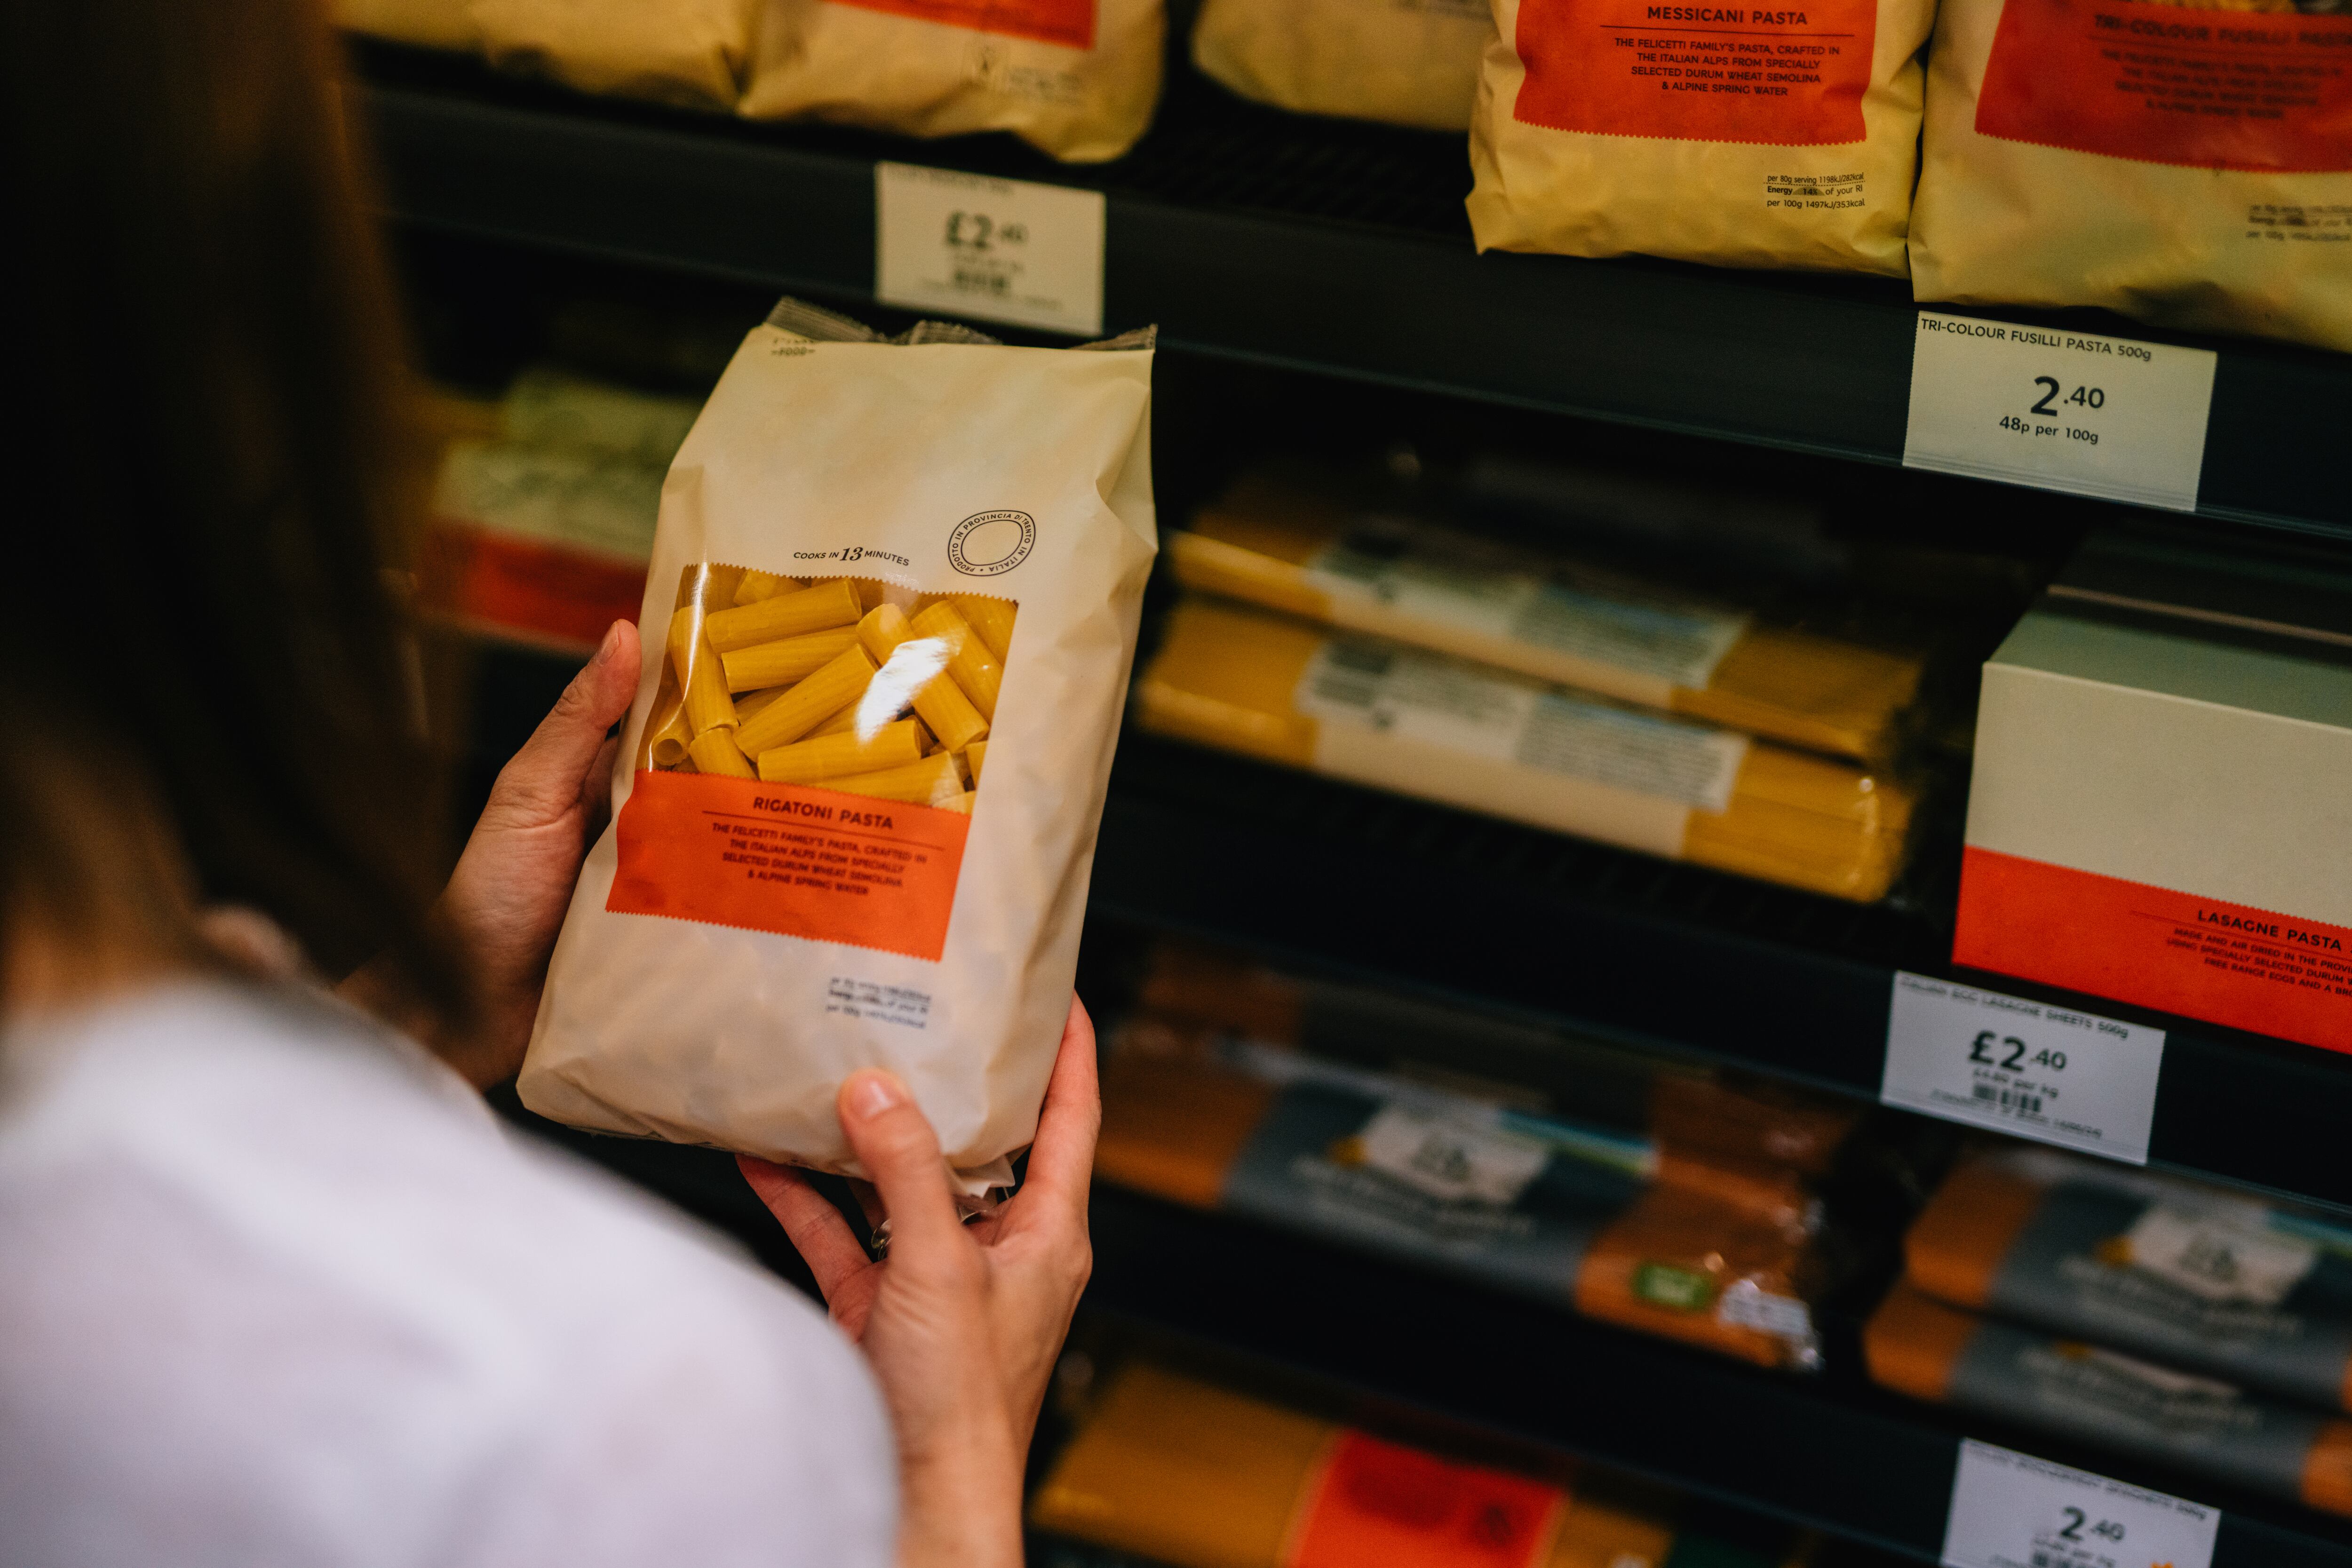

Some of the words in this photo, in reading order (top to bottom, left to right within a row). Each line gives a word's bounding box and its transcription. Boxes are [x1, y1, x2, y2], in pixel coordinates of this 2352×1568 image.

[1647, 7, 1743, 23] MESSICANI
[1752, 11, 1807, 25] PASTA
[1615, 38, 1634, 47] THE
[1638, 39, 1686, 49] FELICETTI
[1690, 41, 1735, 52] FAMILY'S
[1738, 44, 1774, 55] PASTA,
[1777, 46, 1825, 55] CRAFTED
[1637, 53, 1656, 62] THE
[1660, 54, 1699, 64] ITALIAN
[1703, 56, 1728, 65] ALPS
[1732, 58, 1761, 67] FROM
[1765, 59, 1820, 69] SPECIALLY
[1631, 66, 1682, 77] SELECTED
[1685, 69, 1723, 79] DURUM
[1727, 71, 1763, 81] WHEAT
[1766, 72, 1820, 83] SEMOLINA
[1672, 81, 1708, 91] ALPINE
[1712, 84, 1750, 94] SPRING
[1754, 86, 1788, 96] WATER
[1780, 175, 1792, 184] 80g
[1794, 176, 1817, 185] serving
[1819, 172, 1864, 183] 1198kJ/282kcal
[1767, 186, 1793, 195] Energy
[1836, 187, 1853, 196] your
[1784, 200, 1802, 209] 100g
[1806, 199, 1865, 209] 1497kJ/353kcal
[1921, 318, 2005, 340] TRI-COLOUR
[2011, 330, 2061, 347] FUSILLI
[2066, 338, 2112, 354] PASTA
[2117, 345, 2152, 362] 500g
[2030, 375, 2105, 417] 2.40
[1999, 416, 2030, 434] 48p
[2035, 424, 2058, 436] per
[2066, 427, 2098, 445] 100g
[963, 513, 1011, 530] PROVINCIA
[1022, 518, 1032, 543] TRENTO
[955, 531, 964, 540] IN
[840, 547, 863, 561] 13
[864, 550, 909, 566] MINUTES
[952, 543, 976, 572] PRODOTTO
[1017, 547, 1027, 556] IN
[989, 557, 1017, 572] ITALIA
[753, 797, 833, 820] RIGATONI
[840, 809, 893, 829] PASTA
[712, 822, 731, 834] THE
[730, 839, 747, 850] THE
[2197, 909, 2279, 938] LASAGNE
[2287, 928, 2342, 951] PASTA
[2174, 927, 2202, 940] MADE
[2205, 934, 2227, 947] AND
[2231, 940, 2247, 949] AIR
[2250, 943, 2280, 957] DRIED
[2284, 951, 2295, 961] IN
[2298, 954, 2317, 966] THE
[2320, 959, 2352, 974] PROVI
[2200, 944, 2251, 962] SPECIALLY
[2254, 957, 2303, 974] SELECTED
[2306, 968, 2344, 983] DURUM
[2204, 957, 2228, 970] FREE
[2231, 963, 2266, 978] RANGE
[2268, 972, 2296, 985] EGGS
[2298, 979, 2321, 990] AND
[2323, 984, 2331, 993] A
[2046, 1008, 2092, 1029] SHEETS
[1969, 1029, 2067, 1073] £2.40
